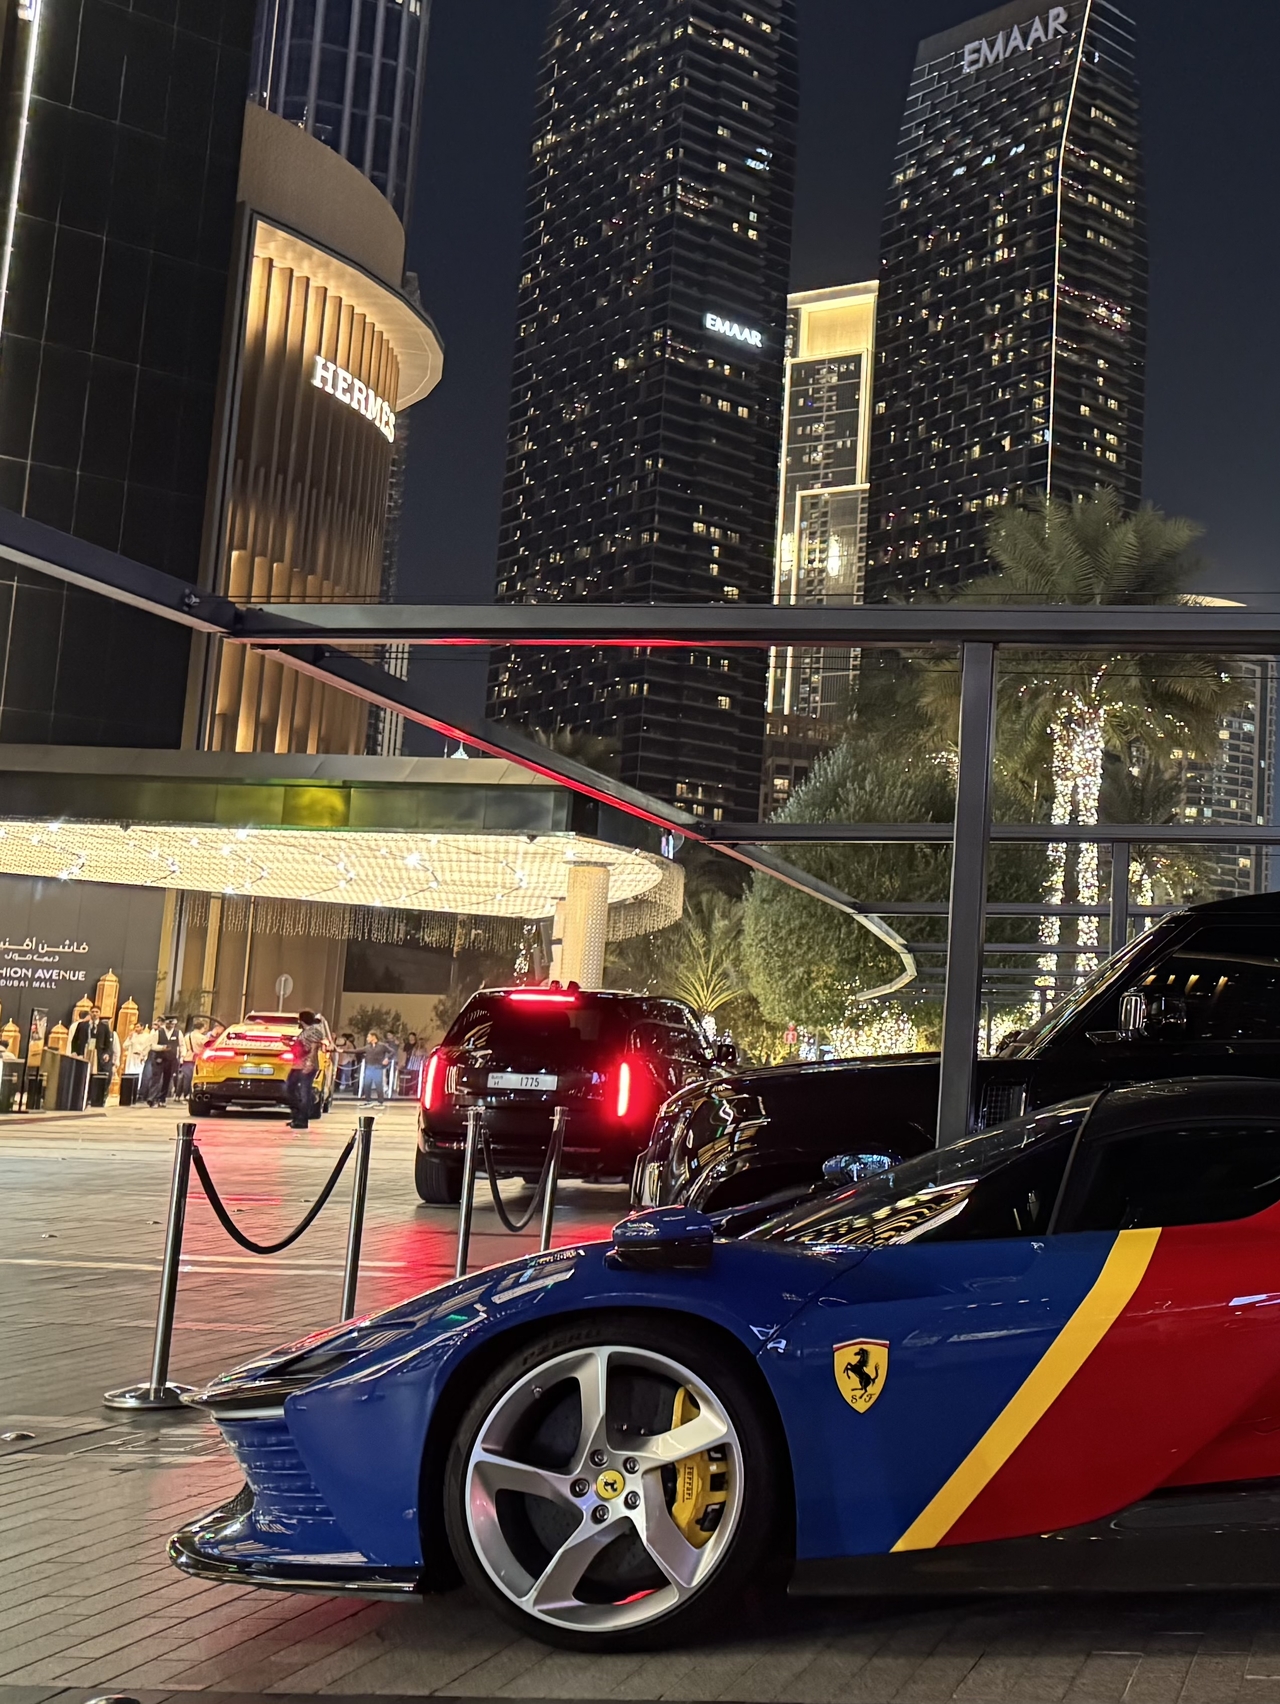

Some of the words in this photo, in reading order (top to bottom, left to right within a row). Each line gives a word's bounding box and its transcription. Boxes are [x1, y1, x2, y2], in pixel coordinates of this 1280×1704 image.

[963, 6, 1068, 74] EMAAR
[705, 313, 762, 347] EMAAR
[4, 951, 33, 961] مول
[35, 969, 86, 981] AVENUE
[520, 1077, 540, 1088] 1775
[850, 1394, 858, 1404] S
[685, 1466, 694, 1501] Ferrari
